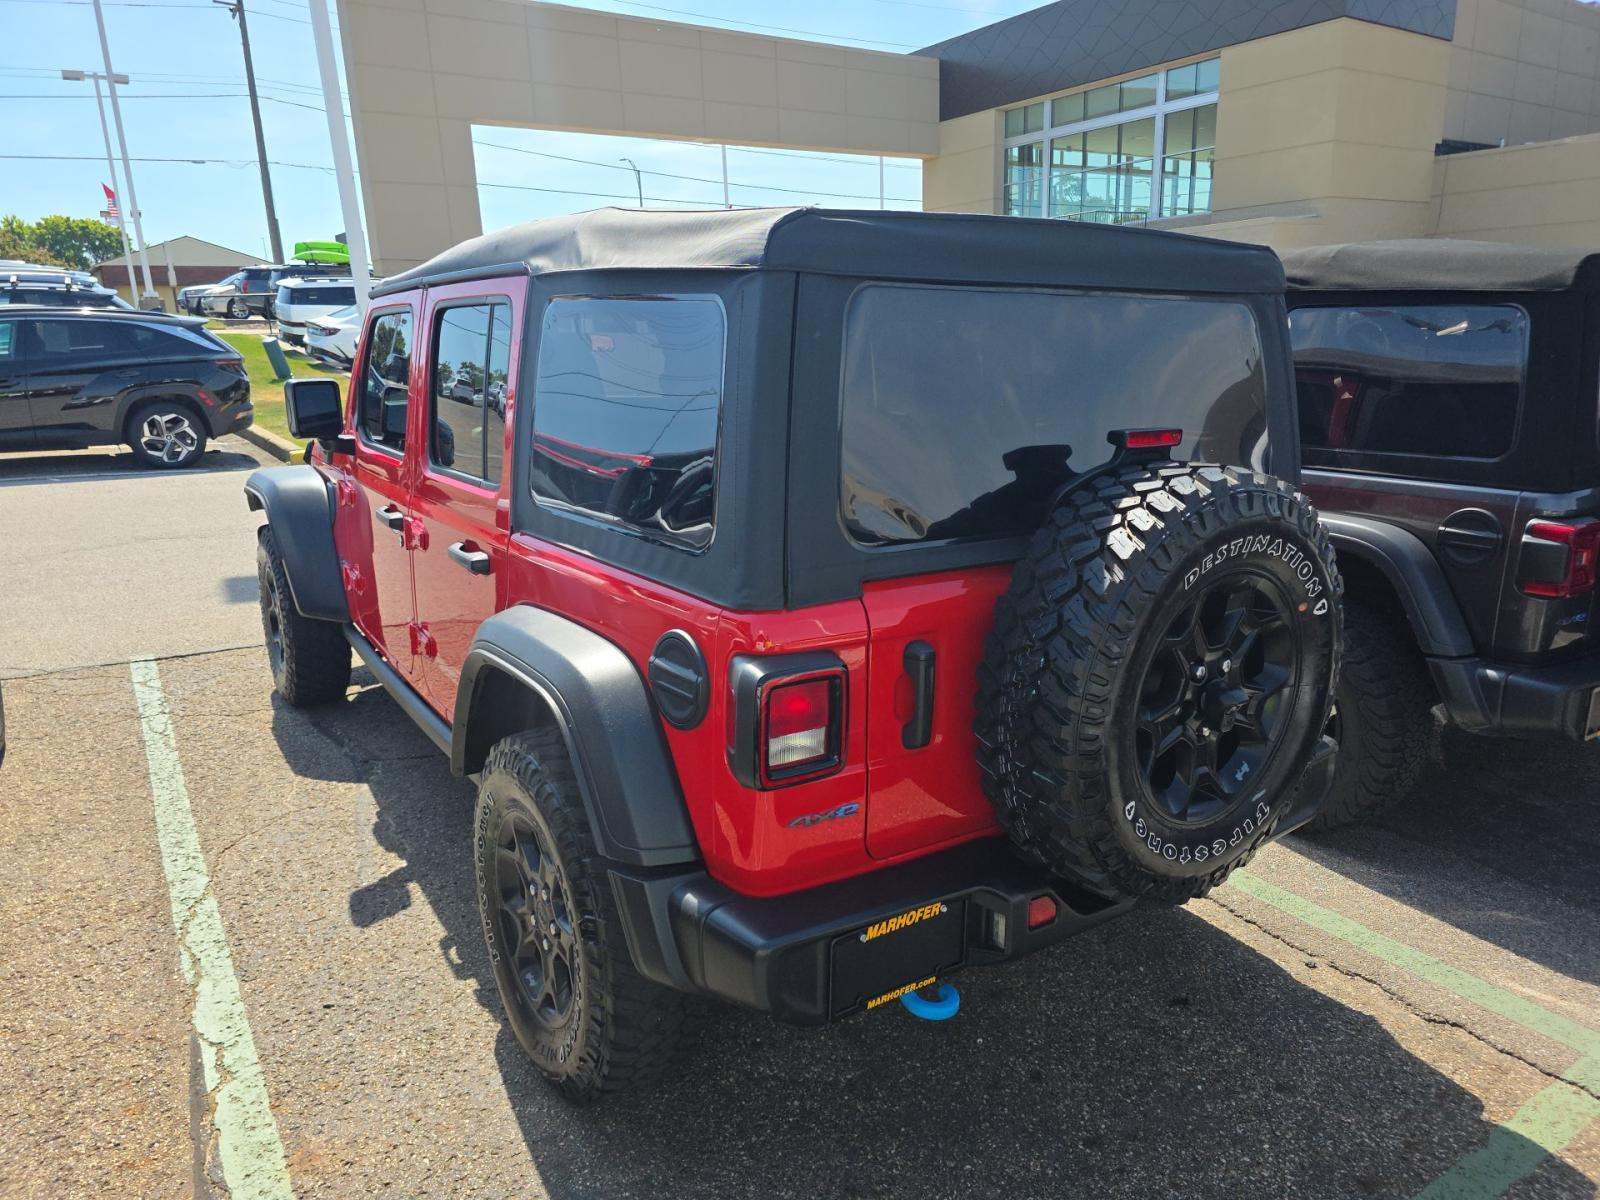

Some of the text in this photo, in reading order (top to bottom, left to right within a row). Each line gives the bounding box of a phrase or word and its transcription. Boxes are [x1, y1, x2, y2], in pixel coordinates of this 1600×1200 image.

[1184, 534, 1323, 597] DESTINATION
[1135, 801, 1270, 865] Firestone
[866, 902, 941, 941] MARHOFER
[867, 976, 937, 1010] MARHOFER.com
